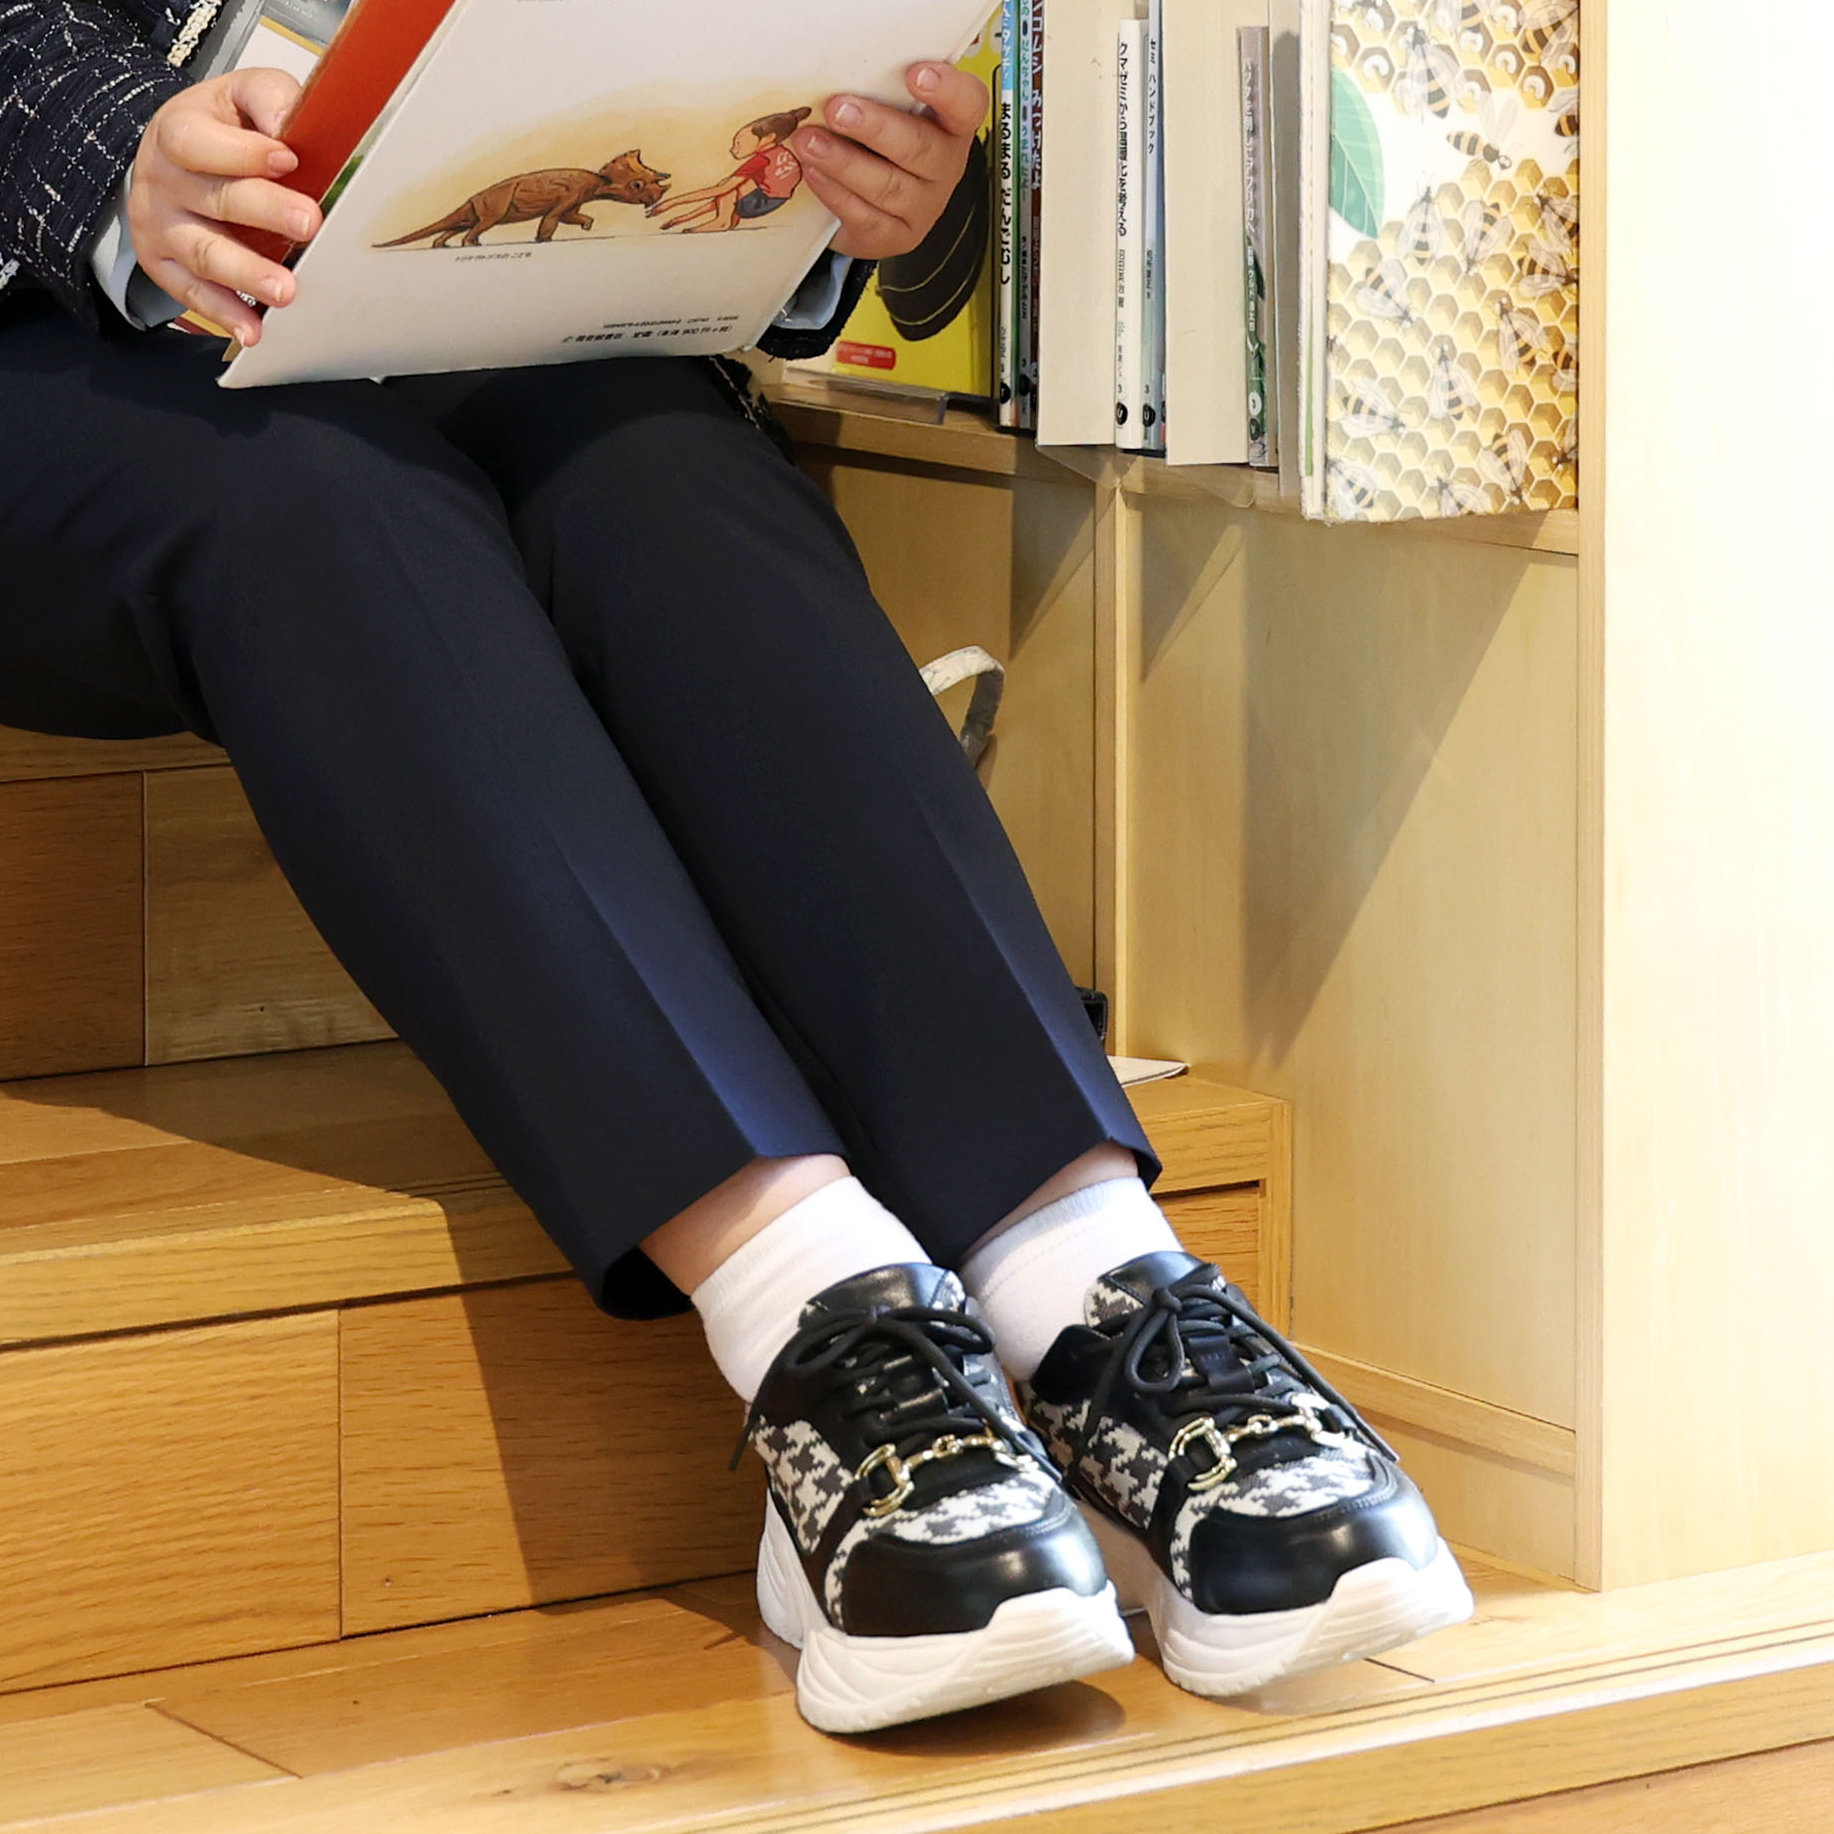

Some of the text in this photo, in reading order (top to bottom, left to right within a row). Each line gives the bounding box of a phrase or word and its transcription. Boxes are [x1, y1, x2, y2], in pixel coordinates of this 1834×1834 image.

[1147, 37, 1157, 155] セミ ハンドブック
[999, 102, 1012, 285] まるまる だんごむし
